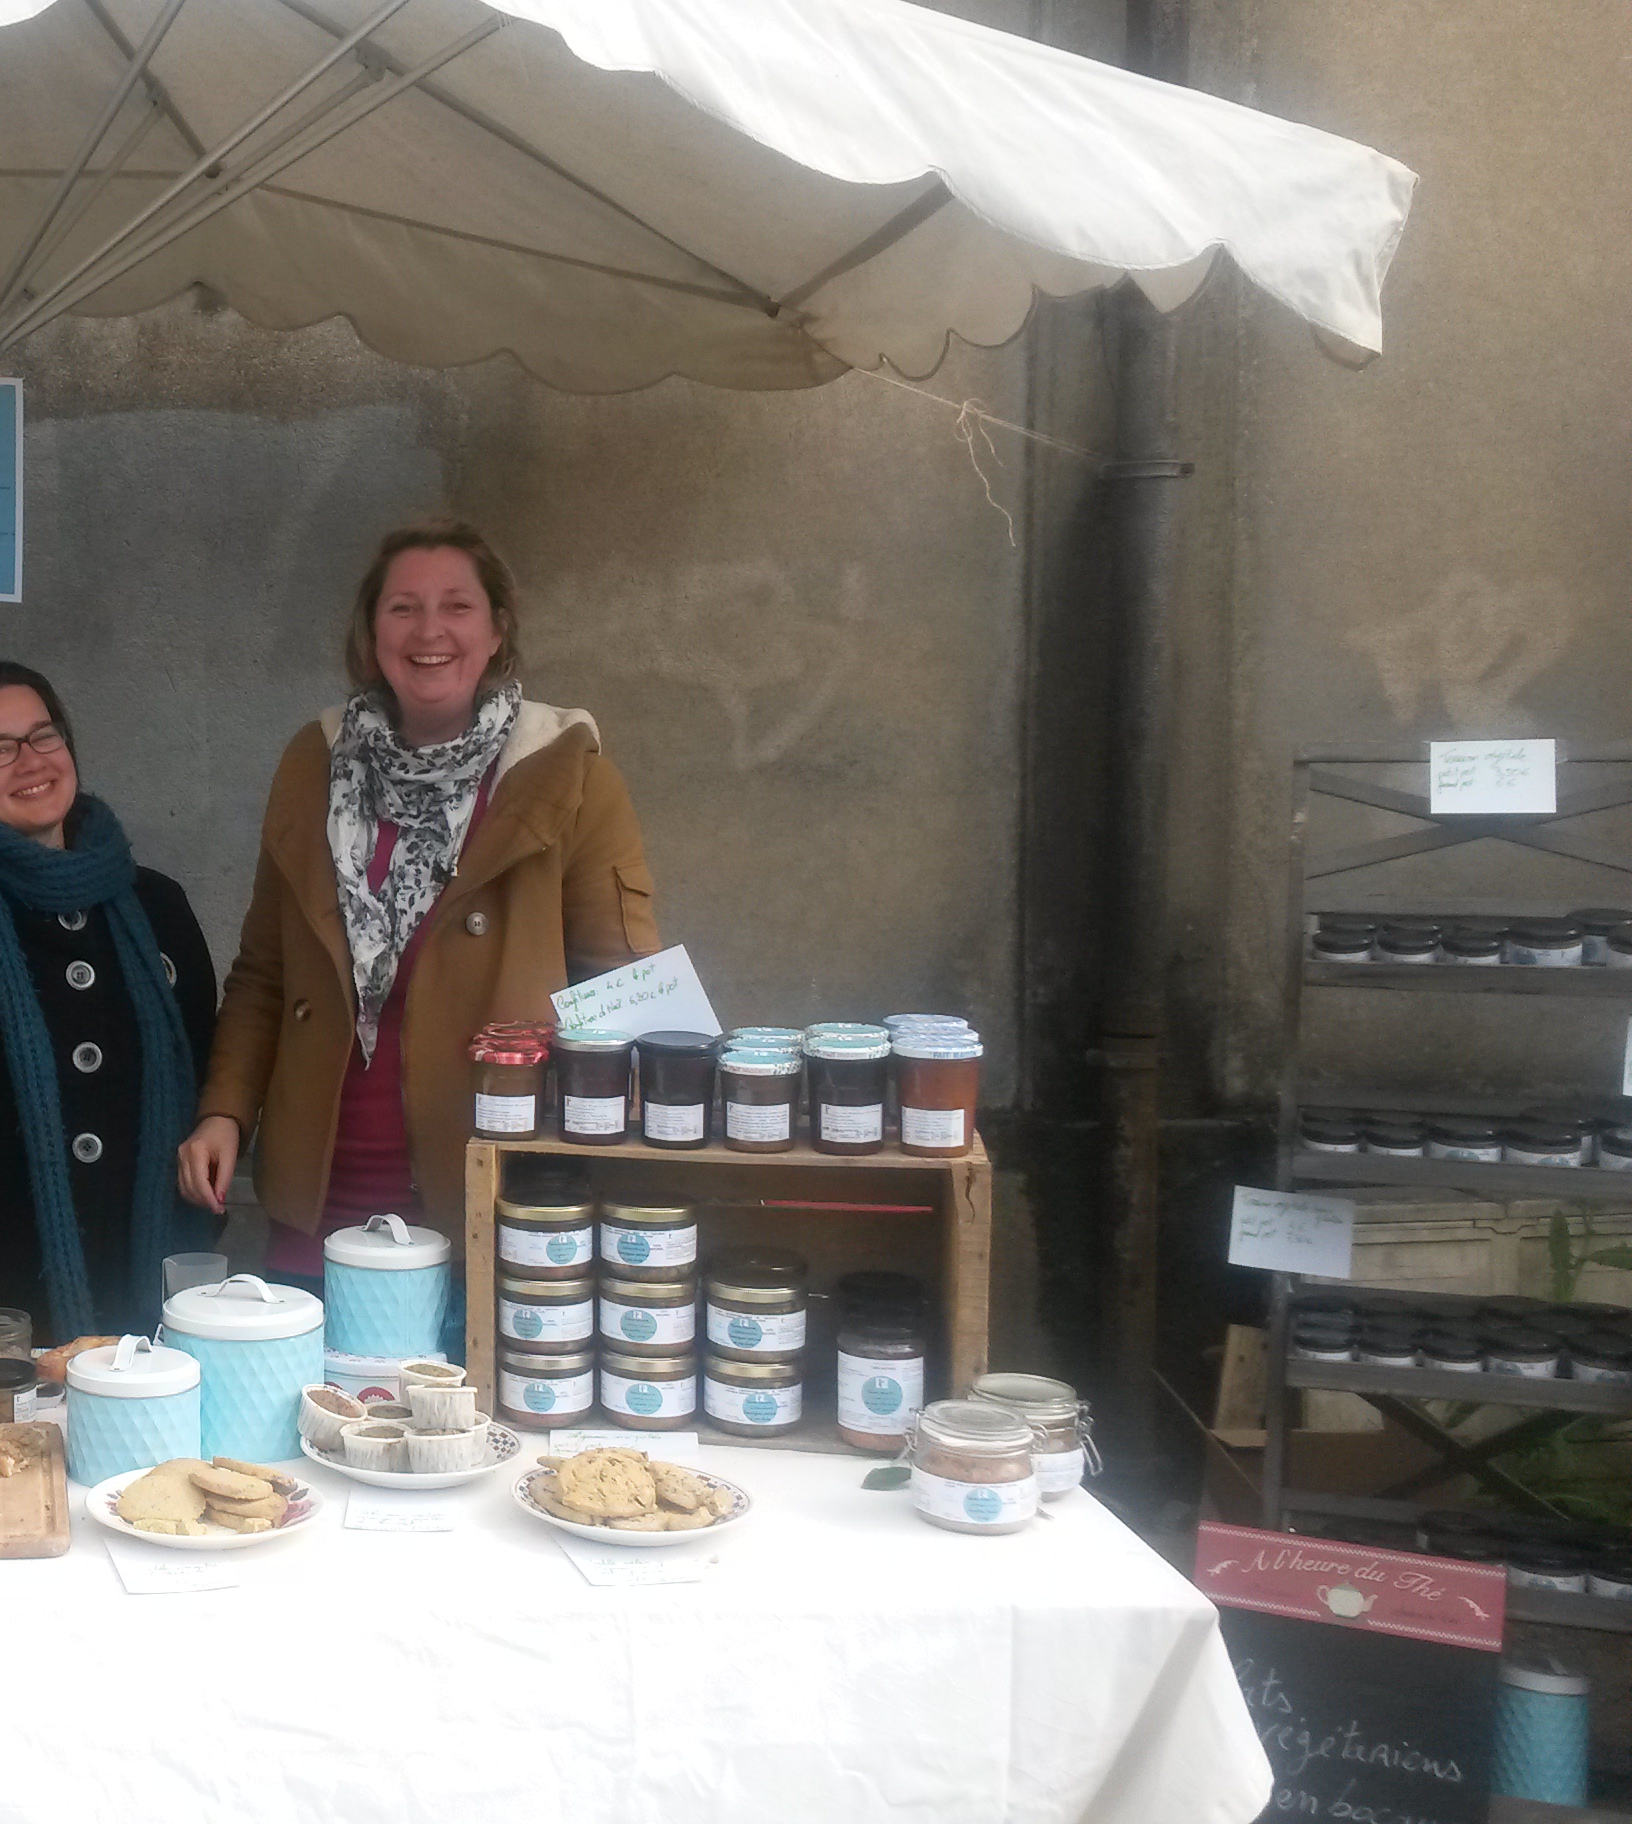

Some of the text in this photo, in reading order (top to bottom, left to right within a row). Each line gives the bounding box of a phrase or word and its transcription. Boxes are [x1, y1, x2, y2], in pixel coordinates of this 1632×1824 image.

[642, 963, 656, 981] pot
[666, 976, 679, 995] pot
[1273, 1549, 1350, 1575] l'heure
[1354, 1560, 1388, 1583] du
[1393, 1571, 1446, 1602] Thé
[1276, 1787, 1320, 1816] en
